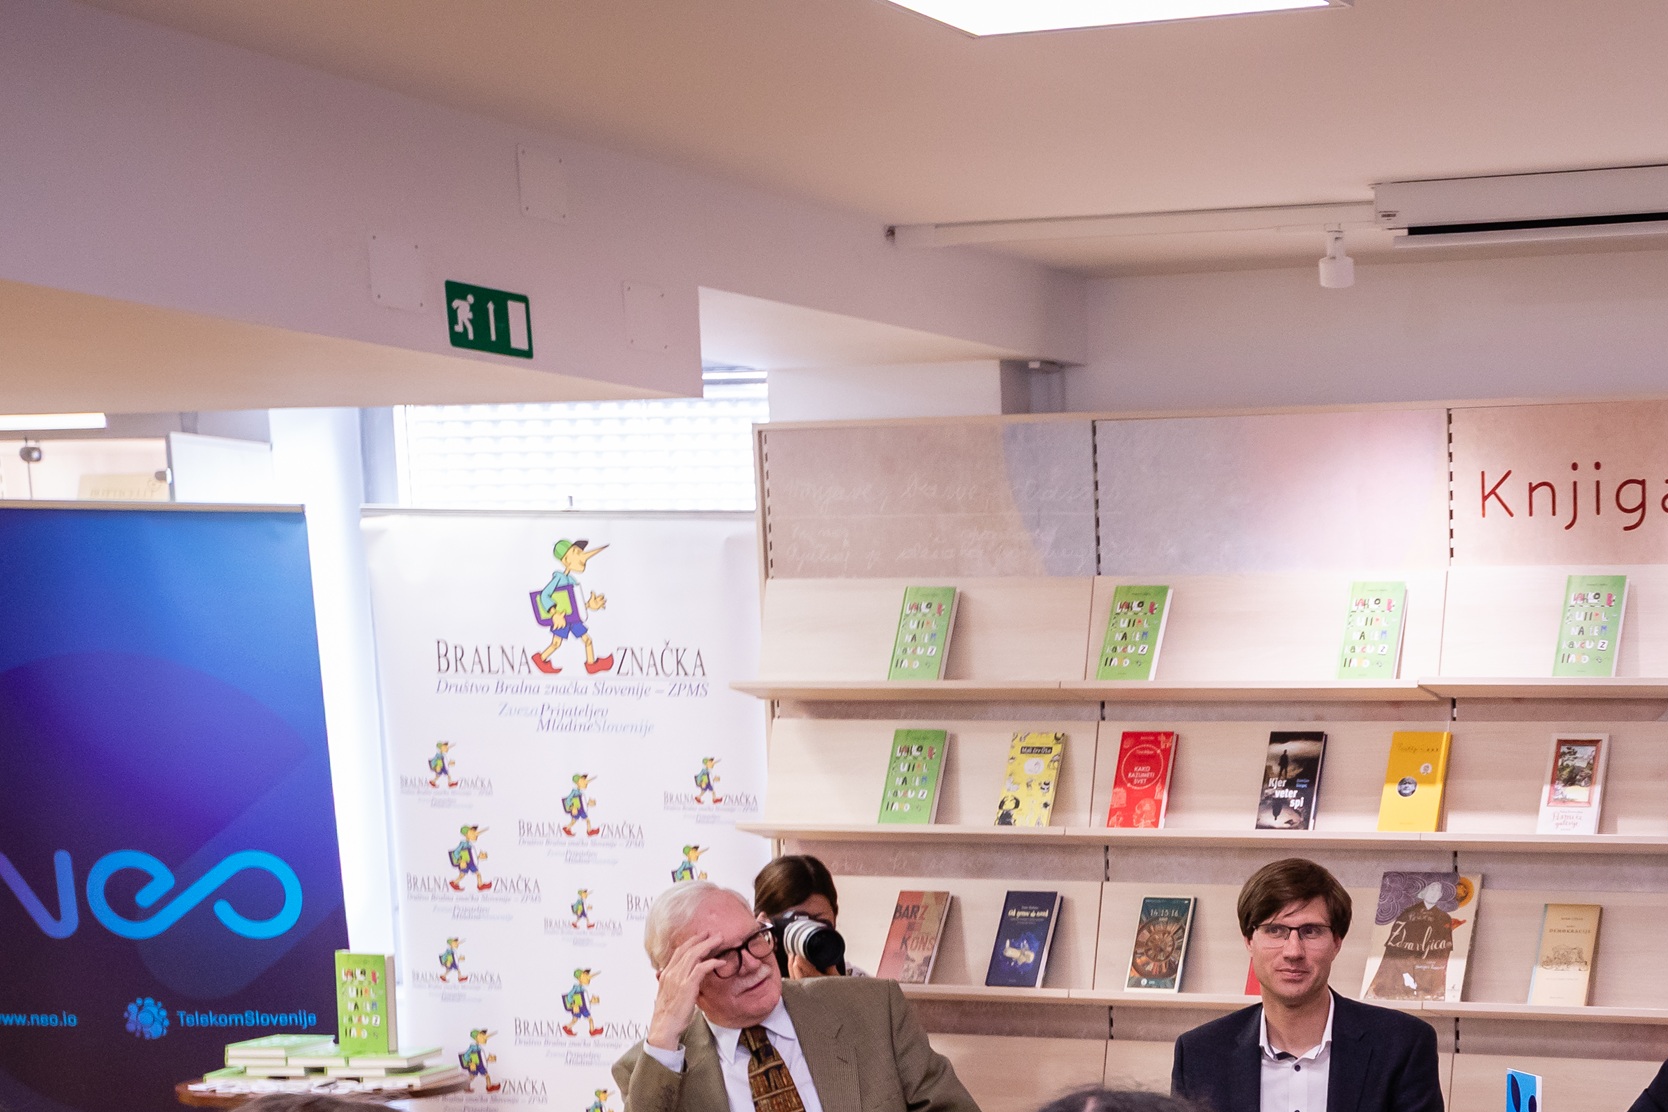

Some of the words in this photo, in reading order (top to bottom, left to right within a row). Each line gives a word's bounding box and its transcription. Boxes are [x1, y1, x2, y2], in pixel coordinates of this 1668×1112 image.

[435, 639, 532, 675] BRALNA
[616, 640, 707, 677] ZNAČKA
[436, 679, 490, 696] Društvo
[494, 680, 541, 696] Bralna
[544, 680, 588, 697] značka
[592, 681, 652, 699] Slovenije
[668, 682, 709, 698] ZPMS
[1268, 777, 1287, 789] Kjer
[1274, 788, 1298, 798] veter
[1289, 796, 1304, 809] spi
[518, 819, 562, 838] BRALNA
[600, 820, 644, 839] ZNAČKA
[406, 872, 450, 892] BRALNA
[493, 874, 542, 893] ZNAČKA
[626, 893, 653, 912] BRA
[176, 1010, 317, 1029] TelekomSlovenije
[514, 1017, 563, 1037] BRALNA
[501, 1077, 547, 1096] ZNAČKA
